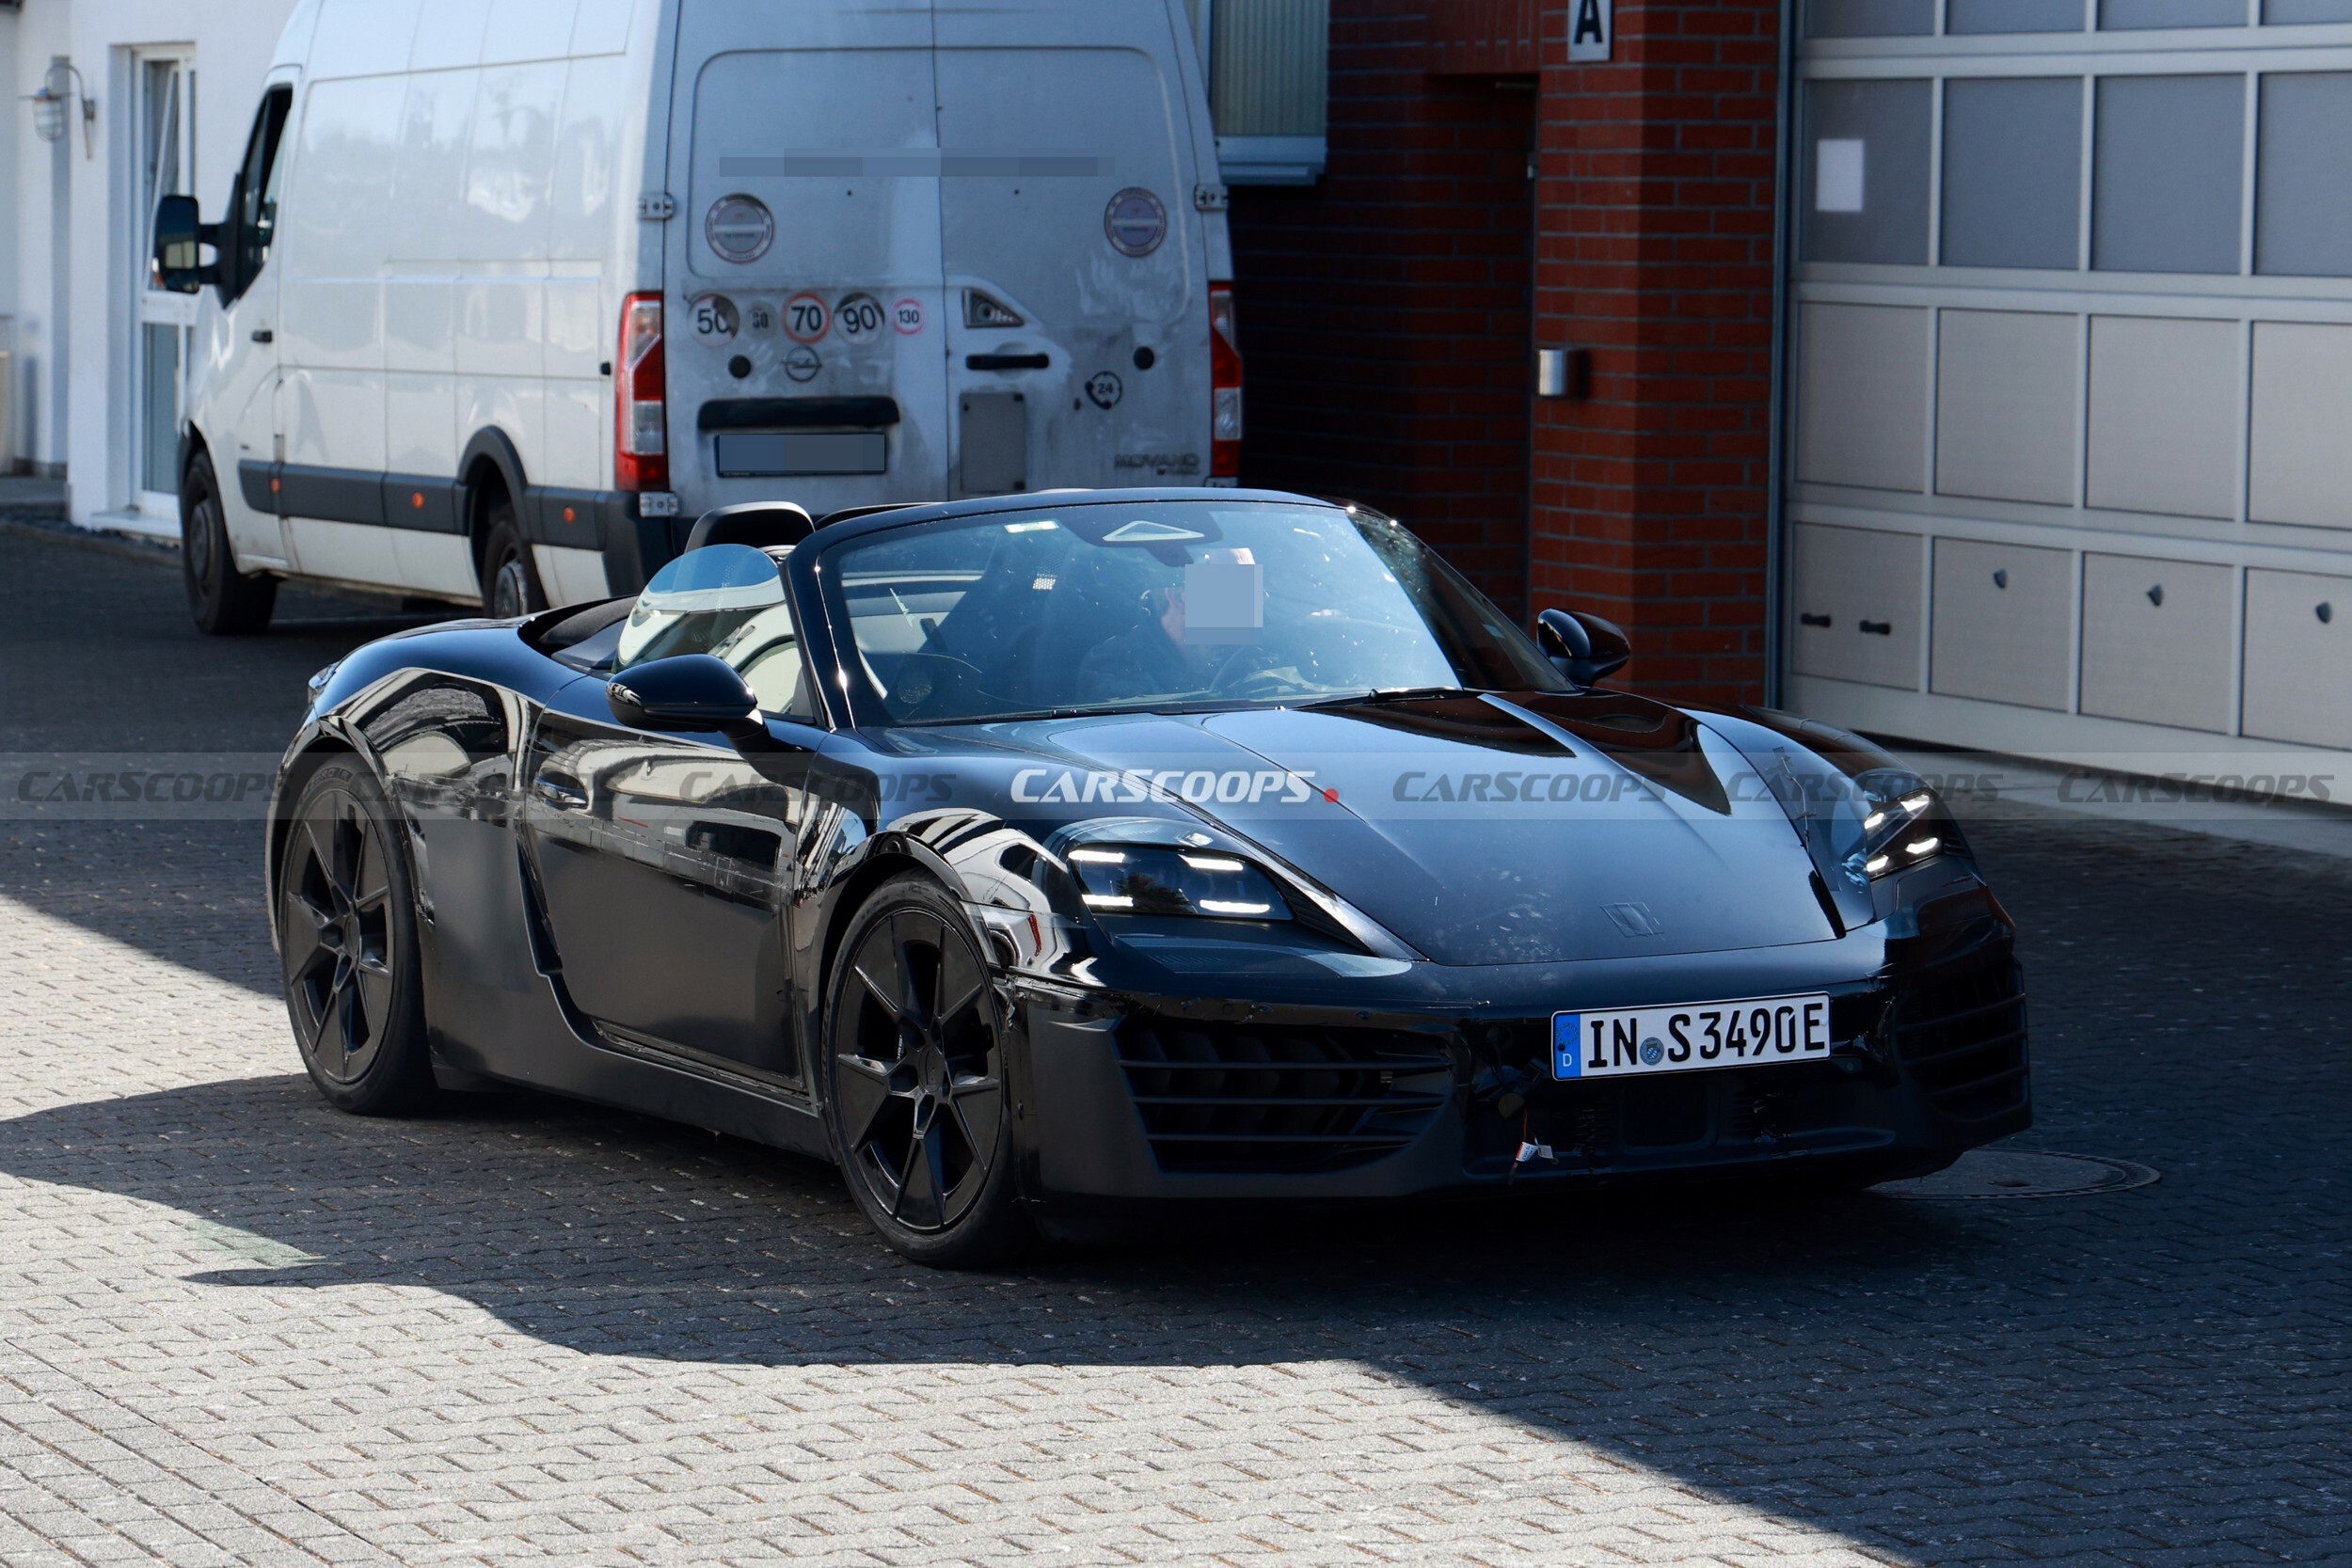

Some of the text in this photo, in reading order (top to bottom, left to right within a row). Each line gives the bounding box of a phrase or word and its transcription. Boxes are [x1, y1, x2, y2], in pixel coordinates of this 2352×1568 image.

[1574, 0, 1603, 44] A
[791, 305, 821, 333] 70
[843, 305, 876, 333] 90
[897, 309, 919, 325] 130
[1098, 383, 1114, 394] 24
[1588, 1017, 1638, 1069] IN
[1562, 1053, 1572, 1068] D
